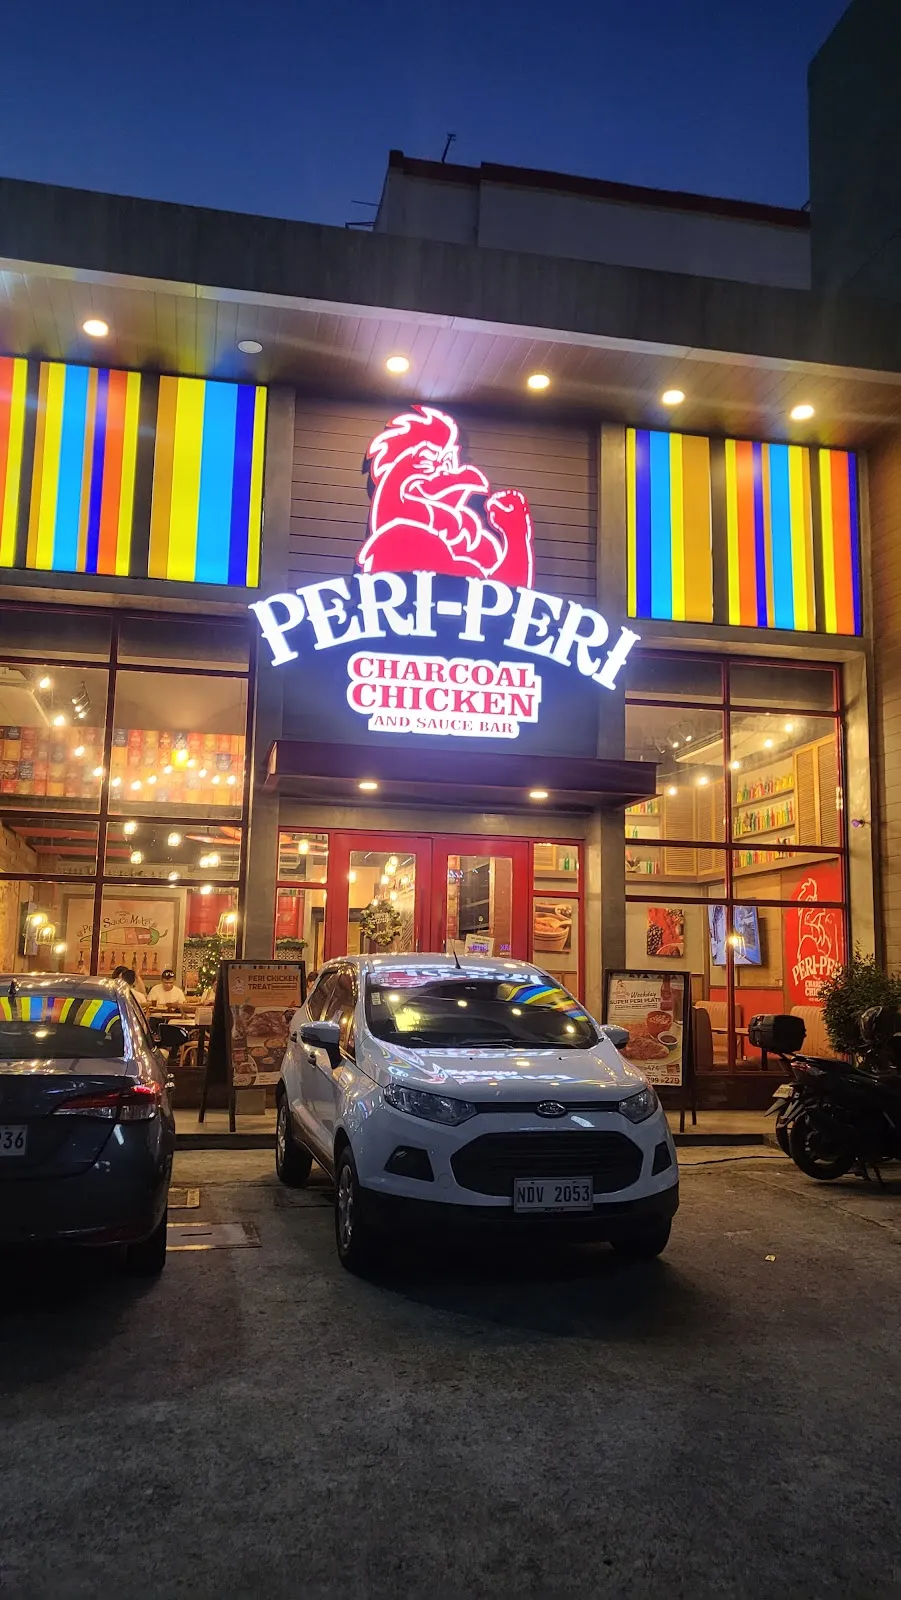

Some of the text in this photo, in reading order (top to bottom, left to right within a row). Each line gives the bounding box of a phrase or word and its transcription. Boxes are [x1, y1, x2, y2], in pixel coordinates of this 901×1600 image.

[247, 569, 642, 691] PERI-PERI
[352, 657, 536, 689] CHARCOAL
[352, 683, 536, 717] CHICKEN
[373, 715, 514, 734] AND SAUCE BAR
[248, 974, 299, 982] PERI CHICKEN
[248, 983, 271, 991] TREAT
[0, 1131, 24, 1149] 36
[517, 1185, 590, 1204] NDV 2053
